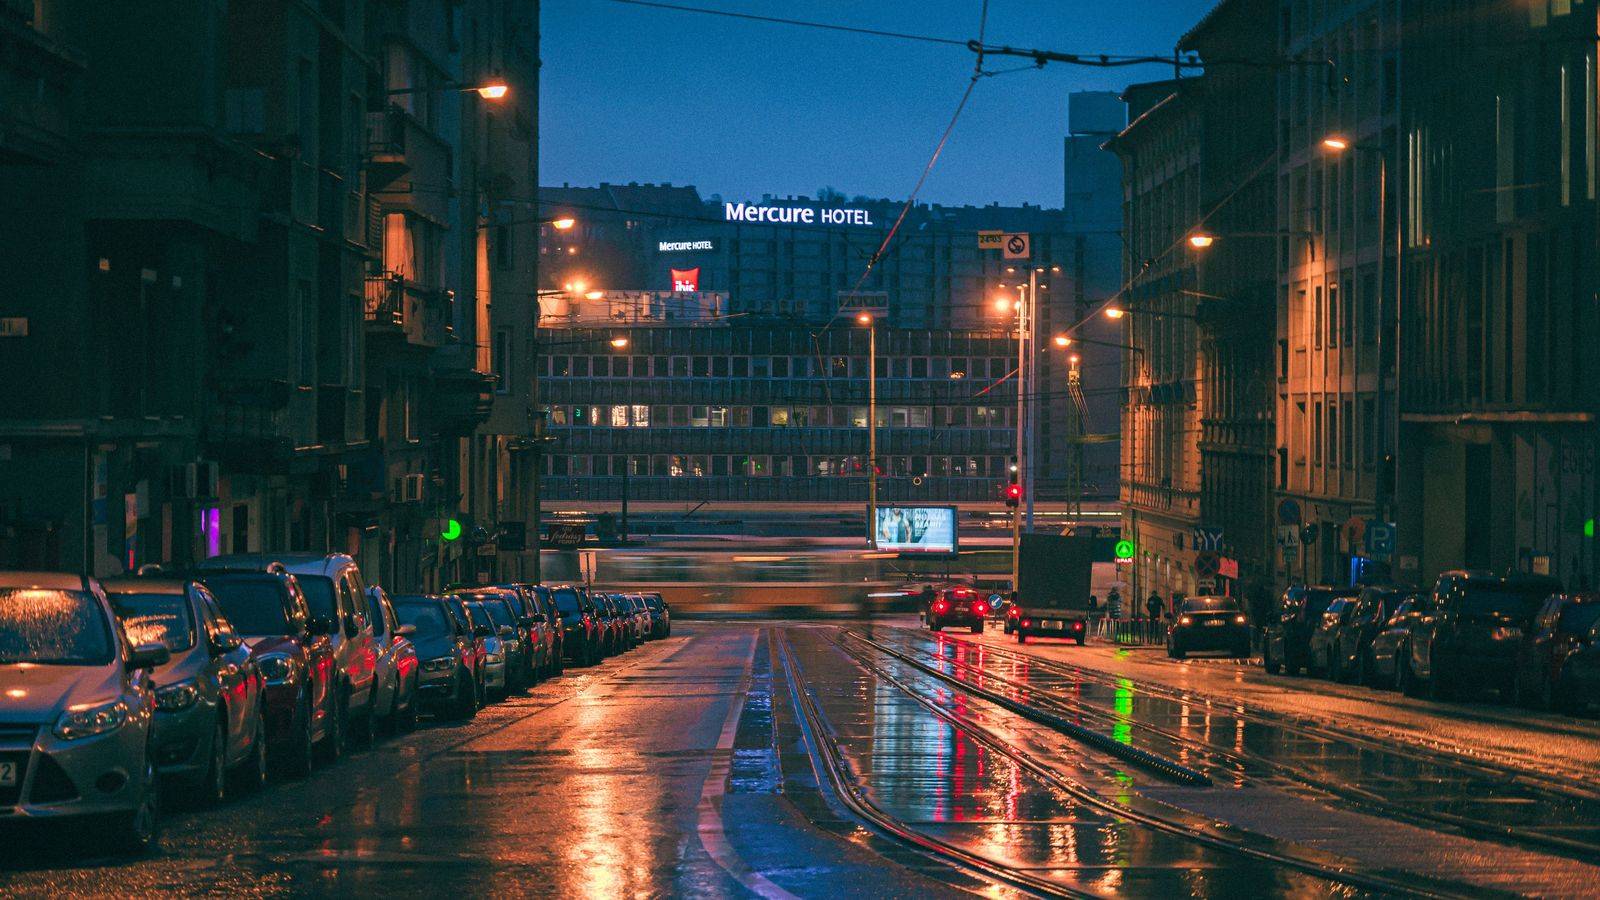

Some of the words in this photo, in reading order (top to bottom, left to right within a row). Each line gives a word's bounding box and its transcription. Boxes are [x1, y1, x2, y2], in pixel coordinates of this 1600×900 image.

[725, 202, 815, 223] Mercure
[821, 208, 873, 225] HOTEL
[659, 241, 692, 251] Mercure
[692, 240, 713, 250] HOTEL
